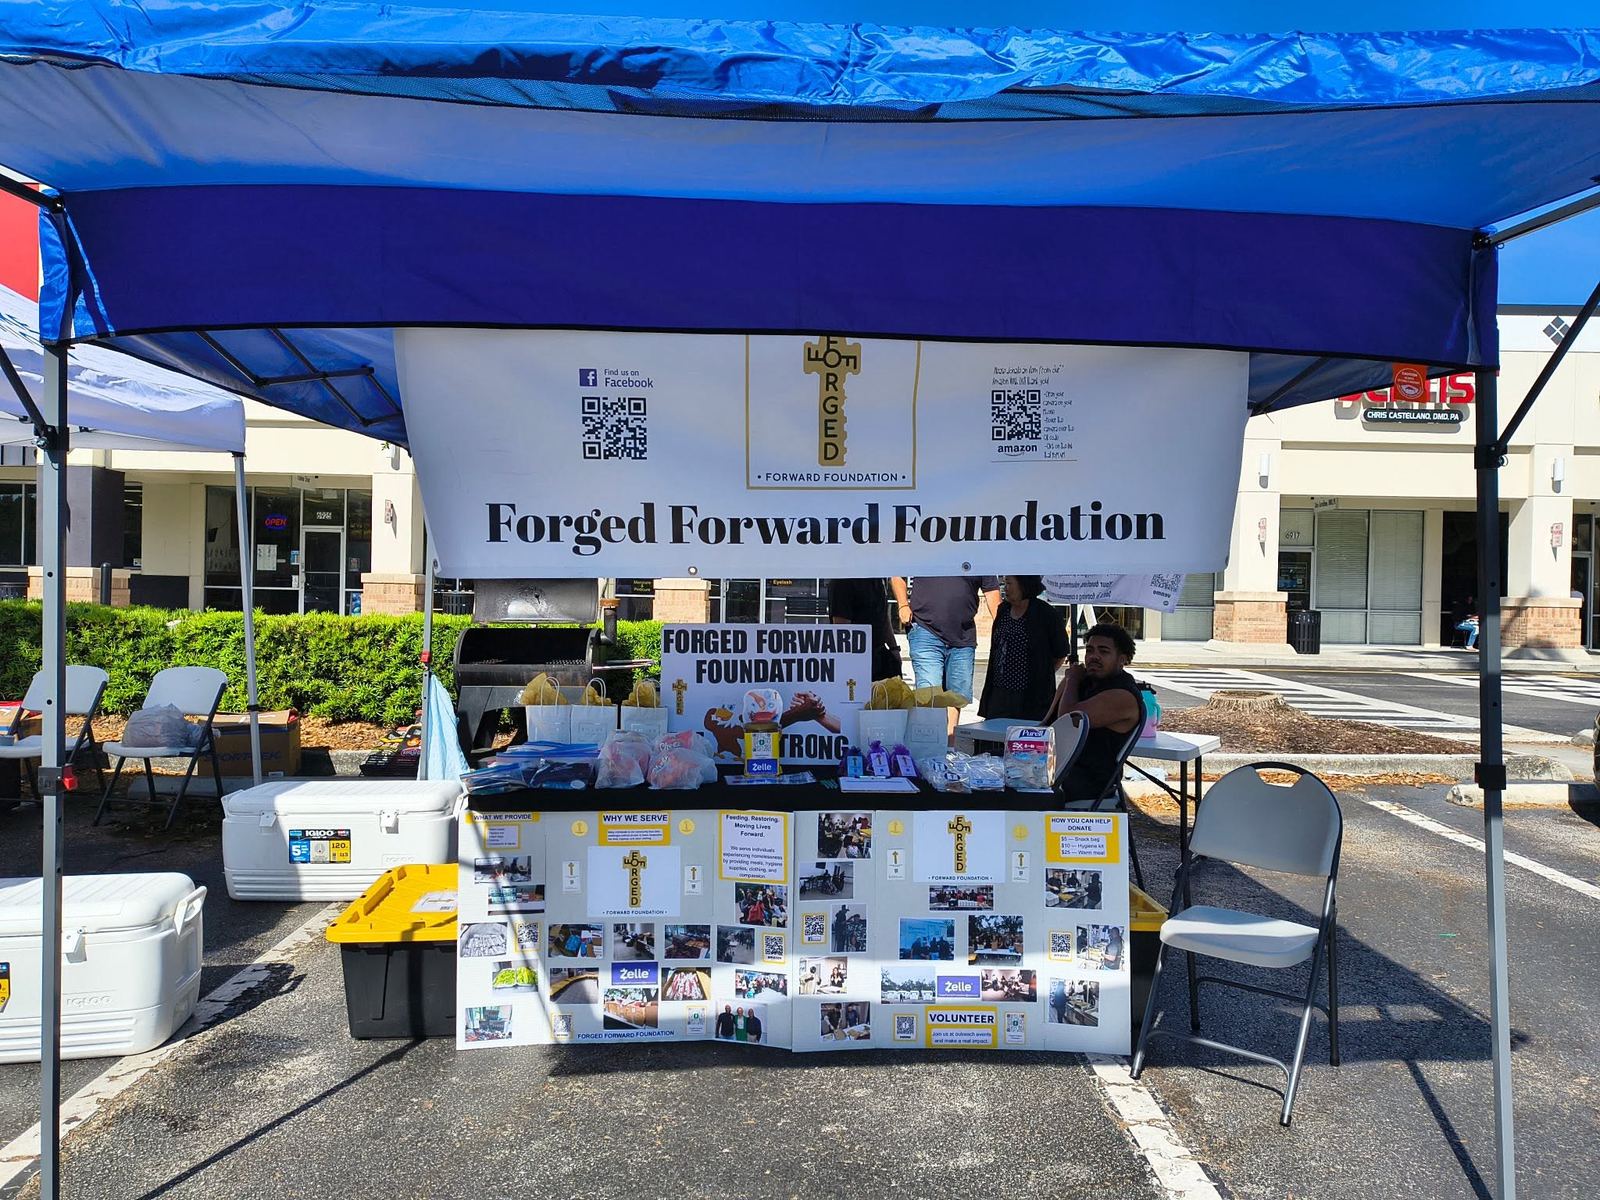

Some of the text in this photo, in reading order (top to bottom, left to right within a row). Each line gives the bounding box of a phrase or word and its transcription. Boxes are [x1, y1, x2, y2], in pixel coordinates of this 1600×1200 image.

[604, 377, 654, 388] Facebook
[997, 444, 1038, 453] amazon
[765, 473, 898, 482] FORWARD FOUNDATION
[264, 517, 288, 527] OPEN
[485, 500, 1166, 557] Forged Forward Foundation
[663, 629, 867, 654] FORGED FORWARD
[696, 658, 835, 684] FOUNDATION
[752, 763, 772, 772] Zelle
[291, 845, 301, 856] 5
[620, 968, 650, 980] Zelle
[944, 981, 972, 993] Zelle
[929, 1013, 994, 1024] VOLUNTEER
